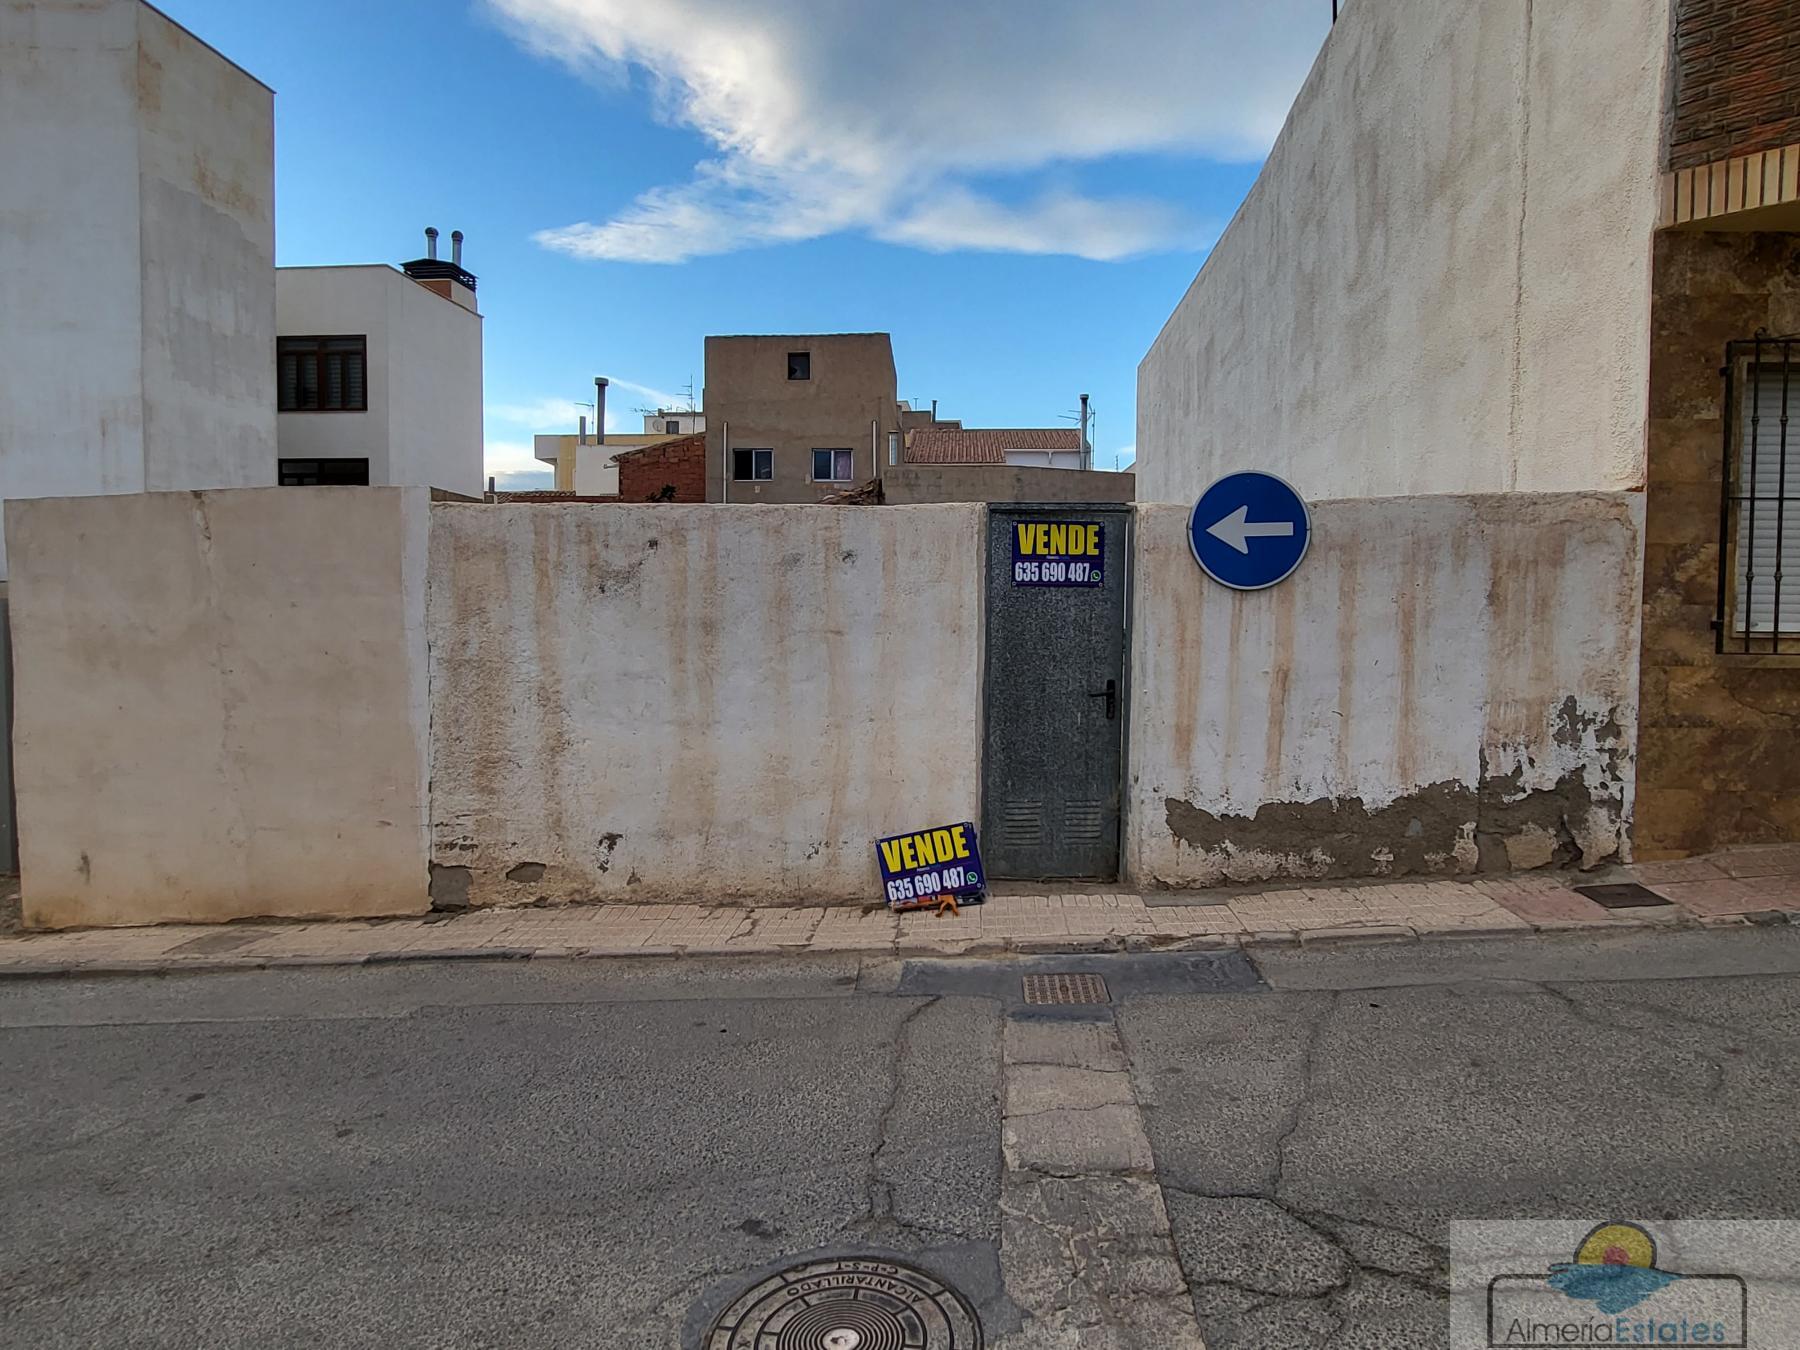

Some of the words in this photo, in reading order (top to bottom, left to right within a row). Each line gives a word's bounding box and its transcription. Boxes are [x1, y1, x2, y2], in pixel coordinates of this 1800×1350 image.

[1017, 523, 1100, 555] VENDE
[1014, 561, 1039, 582] 635
[1041, 562, 1066, 582] 690
[1068, 562, 1090, 582] 487
[880, 825, 970, 873] VENDE
[887, 877, 914, 901] 635
[914, 871, 941, 896] 690
[942, 866, 965, 889] 487
[786, 1274, 924, 1304] ALCANTARILLADO
